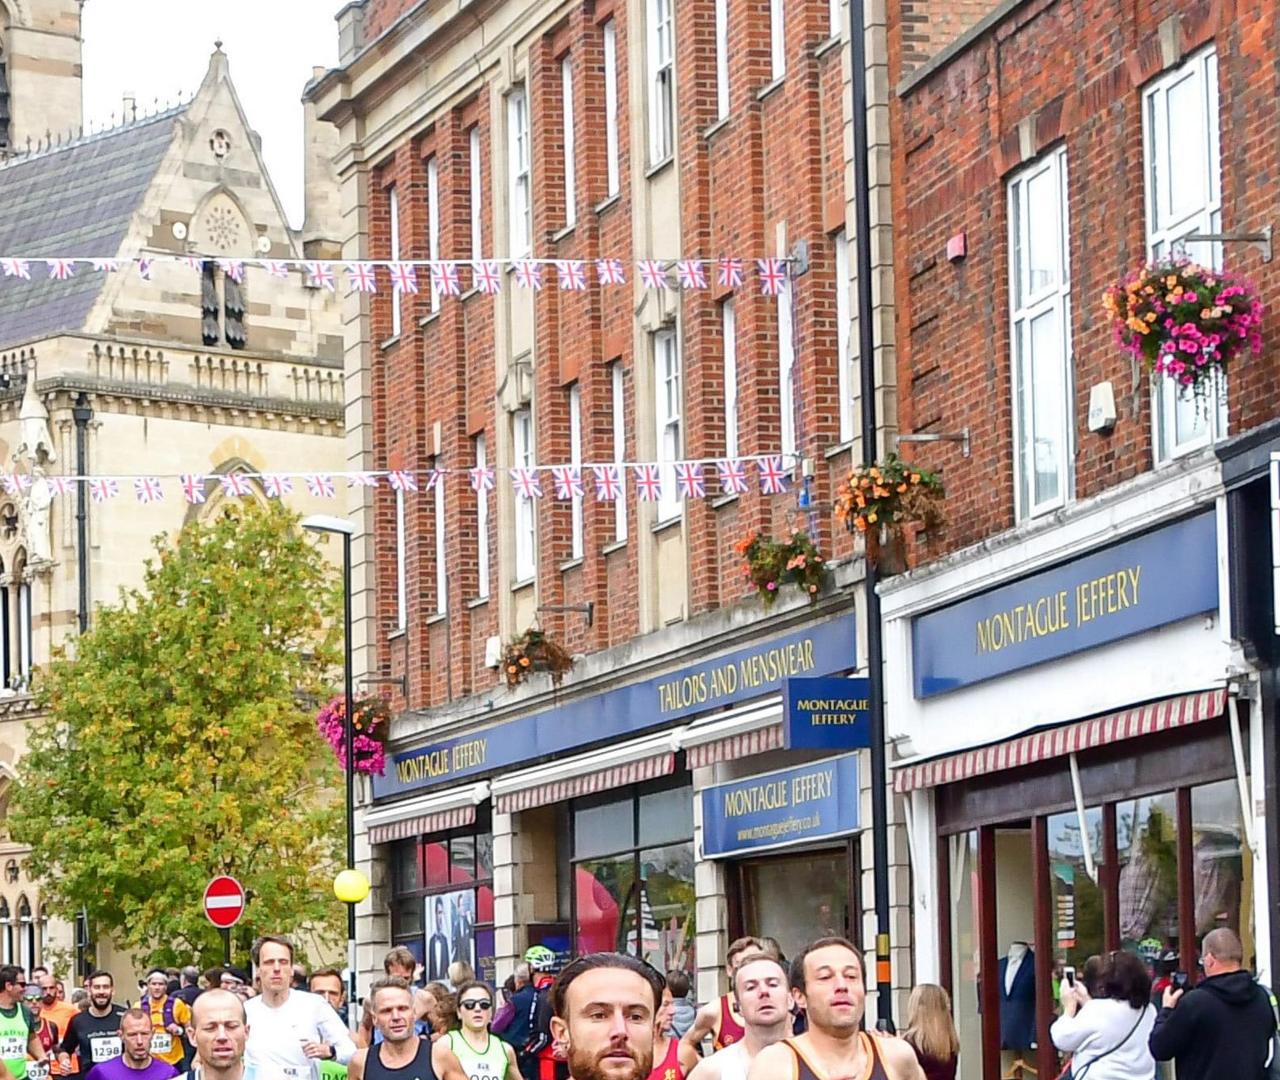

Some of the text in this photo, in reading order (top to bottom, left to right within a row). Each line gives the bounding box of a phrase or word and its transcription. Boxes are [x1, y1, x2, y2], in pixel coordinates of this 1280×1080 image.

[976, 565, 1141, 656] MONTAGUE JEFFERY
[659, 639, 815, 713] TAILORS AND MENSWEAR
[797, 700, 869, 711] MONTAGUE
[811, 714, 856, 725] JEFFERY
[397, 739, 487, 784] MONTAGUE JEFFERY
[725, 770, 833, 818] MONTAGUE JEFFERY
[94, 1047, 119, 1056] 1298
